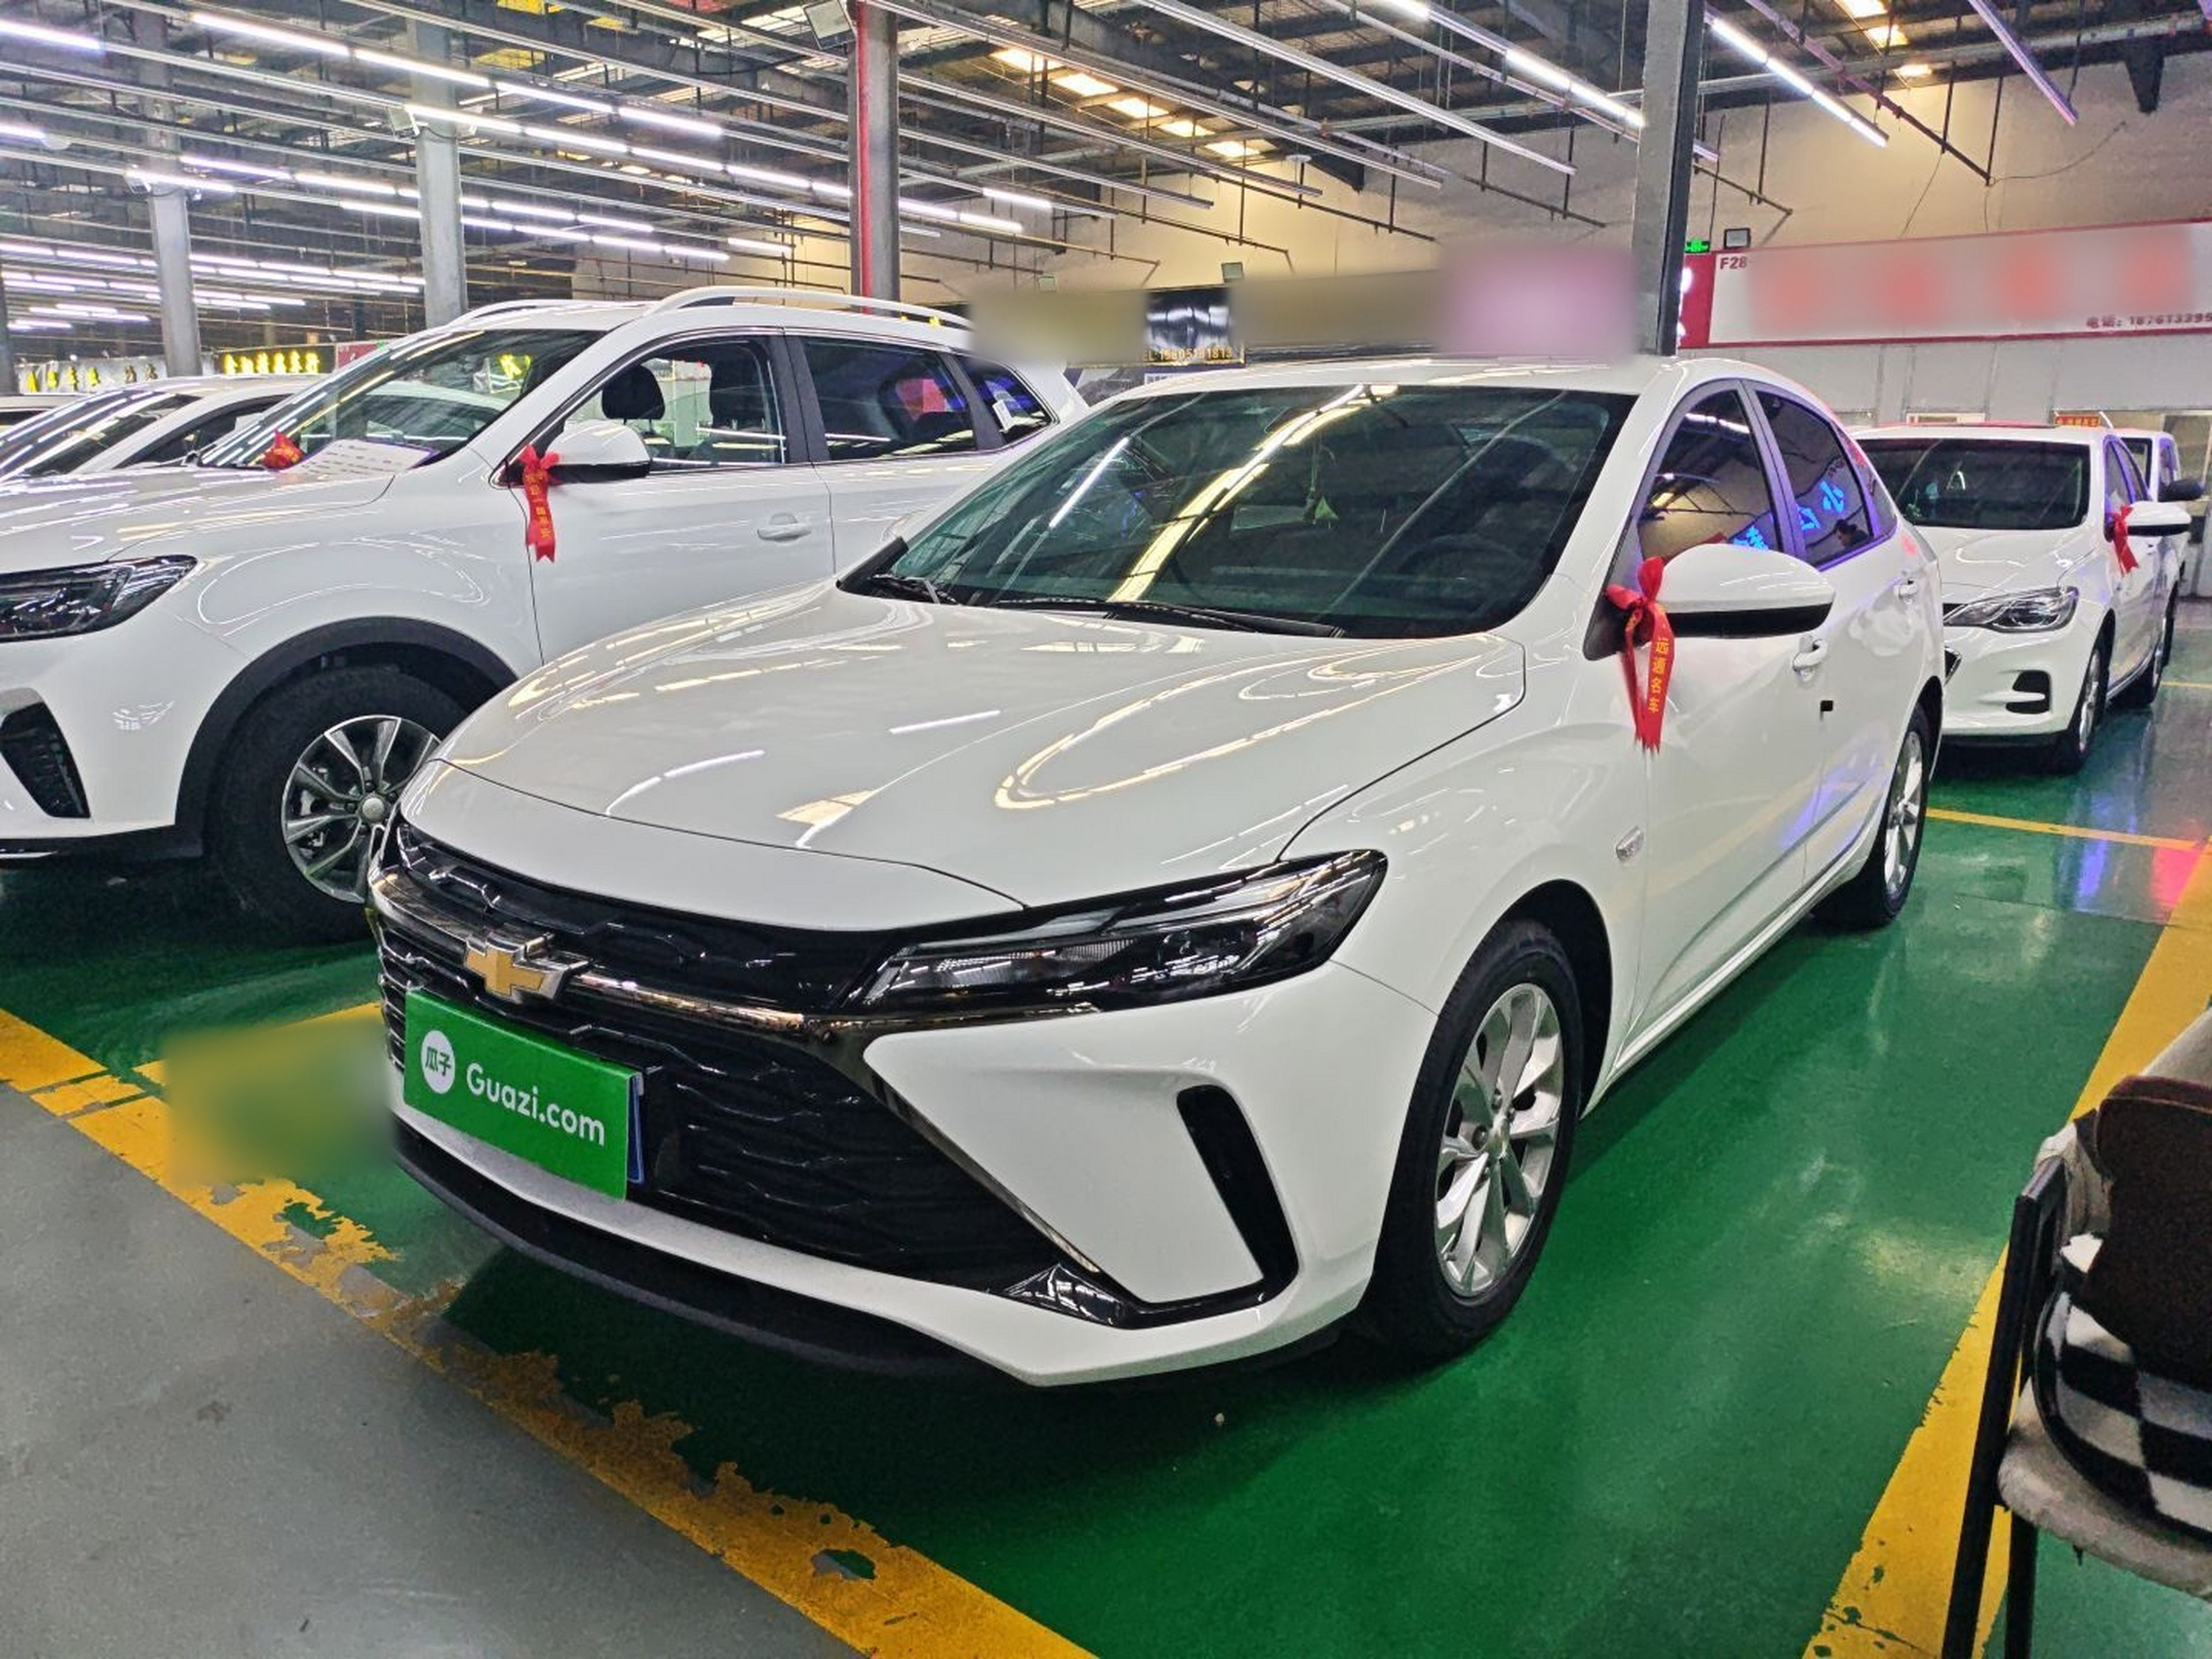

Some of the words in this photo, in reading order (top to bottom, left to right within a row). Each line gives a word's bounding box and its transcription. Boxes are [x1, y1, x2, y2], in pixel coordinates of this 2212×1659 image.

[1720, 256, 1747, 270] F28
[424, 1046, 452, 1075] 瓜子
[467, 1062, 605, 1146] Guazi.com
